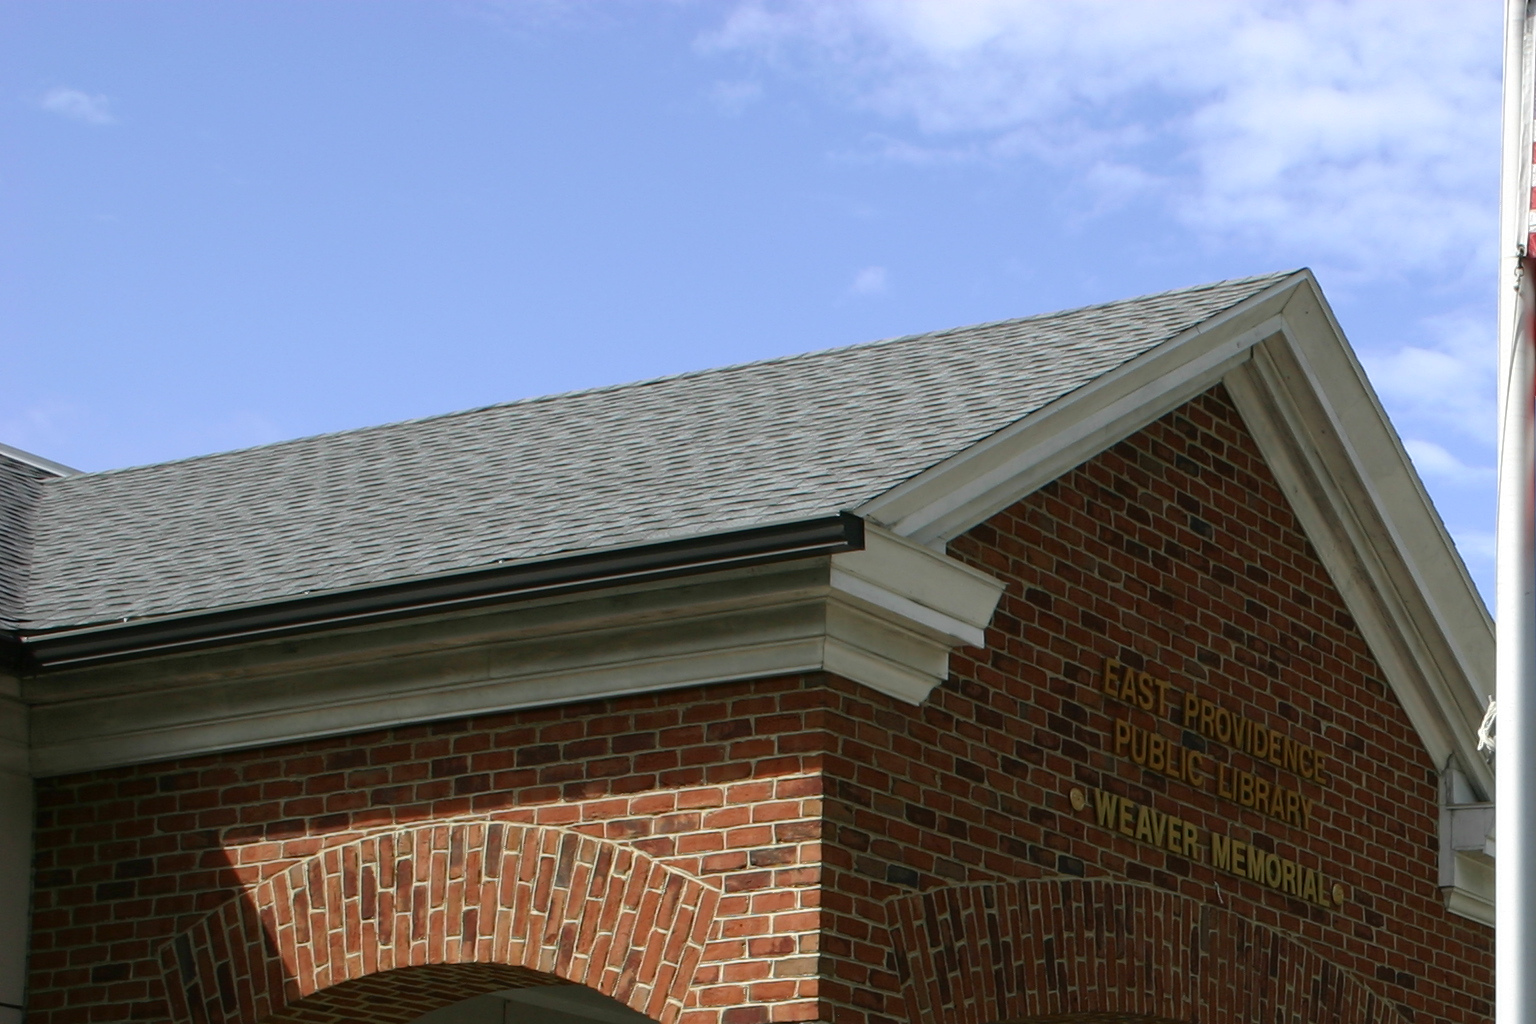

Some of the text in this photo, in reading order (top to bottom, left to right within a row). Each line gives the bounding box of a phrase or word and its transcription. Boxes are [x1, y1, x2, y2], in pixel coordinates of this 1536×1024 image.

[1103, 658, 1328, 785] EAST PROVIDENCE
[1113, 718, 1314, 831] PUBLIC LIBRARY
[1093, 787, 1331, 908] WEAVER MEMORIAL
